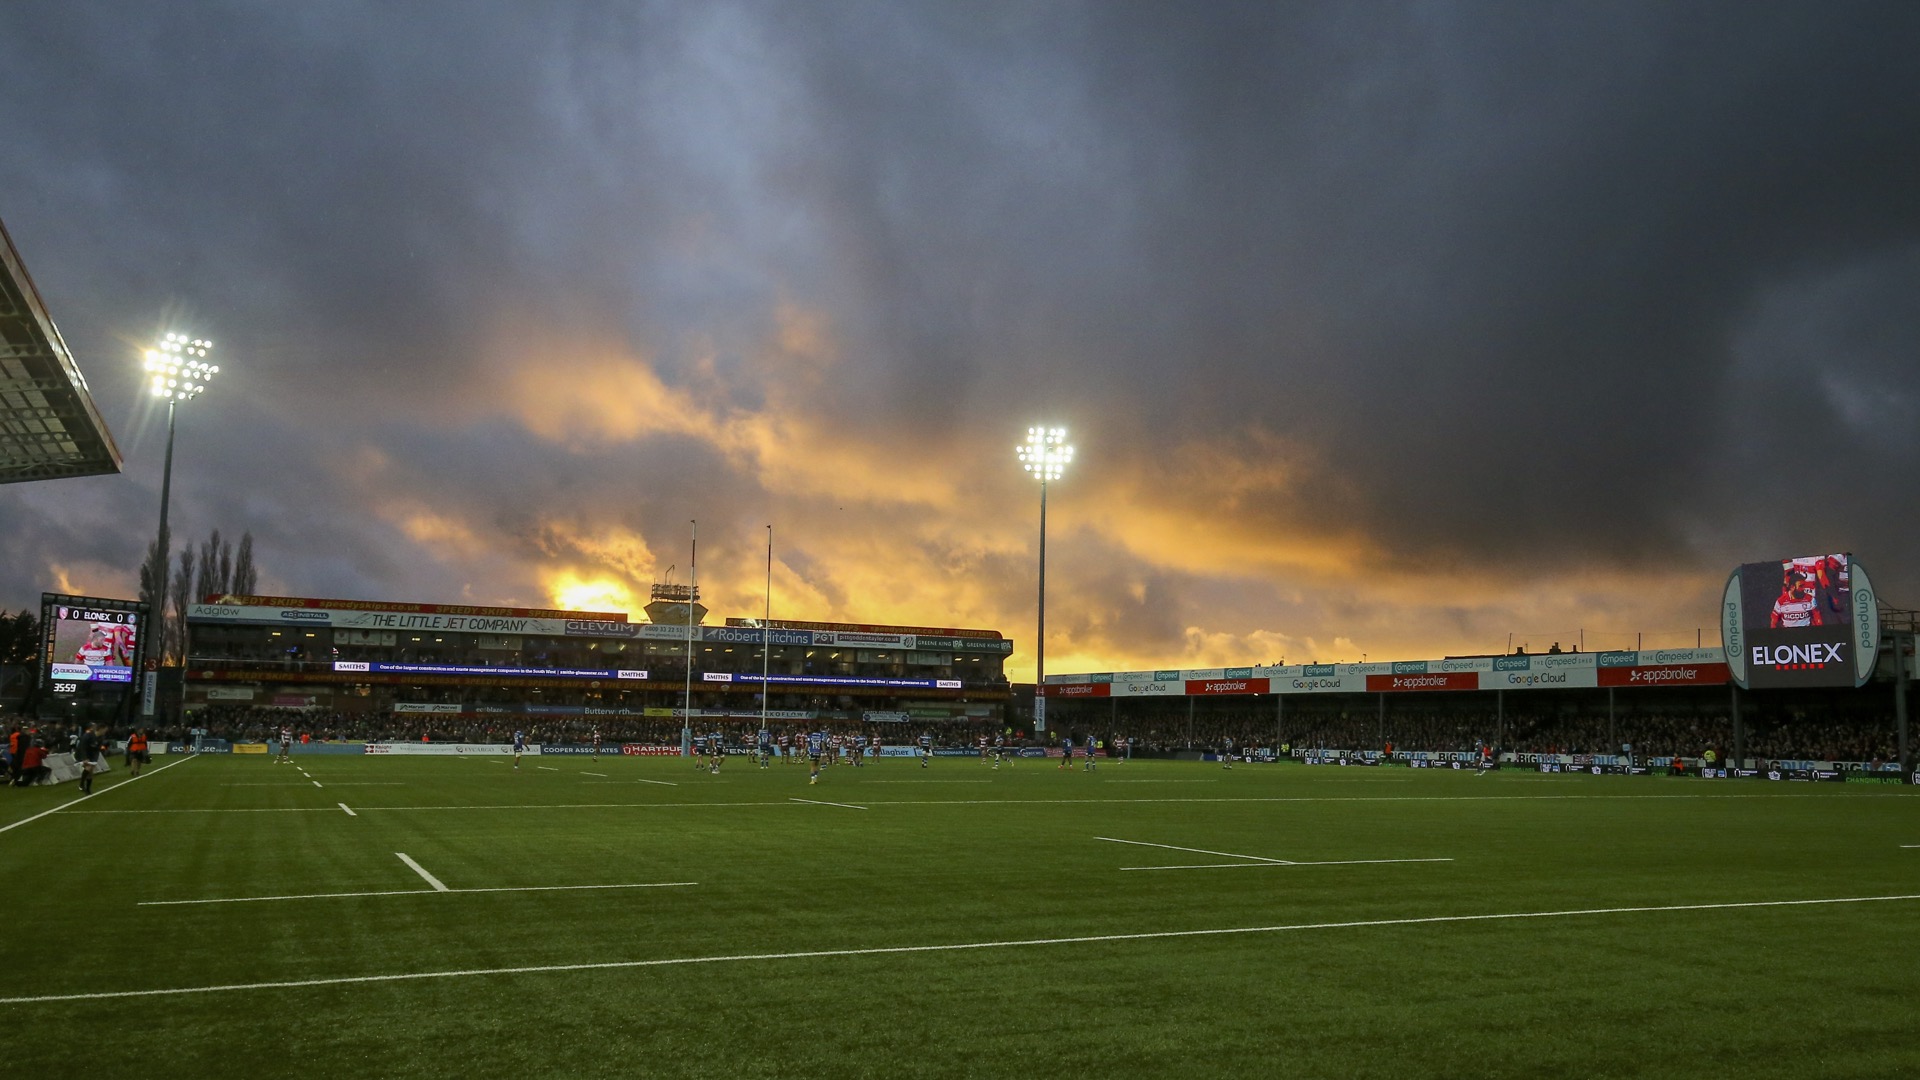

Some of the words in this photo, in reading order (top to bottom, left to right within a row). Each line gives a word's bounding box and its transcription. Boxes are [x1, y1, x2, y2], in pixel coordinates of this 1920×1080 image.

[270, 596, 305, 607] SKIPS
[319, 600, 420, 612] speedyskips.co.uk
[72, 609, 80, 619] 0
[84, 611, 112, 621] ELONEX
[116, 613, 124, 623] 0
[194, 605, 240, 617] Adglow
[435, 606, 478, 614] SPEEDY
[481, 608, 513, 616] SKIPS
[527, 610, 568, 618] SPEEDY
[373, 614, 397, 626] THE
[399, 615, 440, 628] LITTLE
[443, 617, 467, 629] JET
[468, 619, 528, 632] COMPANY
[1854, 588, 1874, 649] Compeed
[566, 622, 634, 632] GLEVUM
[796, 622, 831, 630] SPEEDY
[870, 626, 944, 635] speedyskips.co.uk
[1726, 602, 1742, 658] Compeed
[718, 628, 760, 642] Robert
[762, 630, 809, 644] Hitchins
[814, 634, 834, 642] PGT
[952, 640, 964, 648] IPA
[1000, 642, 1011, 650] IPA
[1655, 651, 1693, 664] Compeed
[1752, 642, 1843, 665] ELONEX
[1496, 658, 1527, 671] Compeed
[1544, 657, 1577, 669] Compeed
[1600, 653, 1634, 666] Compeed
[1305, 665, 1332, 676] Compeed
[1347, 664, 1376, 675] Compeed
[1394, 662, 1425, 674] Compeed
[1441, 660, 1473, 672] Compeed
[1122, 673, 1142, 682] Compeed
[1156, 671, 1178, 681] Compeed
[1189, 670, 1212, 680] Compeed
[1226, 669, 1250, 678] Compeed
[1263, 667, 1288, 677] Compeed
[1642, 667, 1697, 684] appsbroker
[1092, 674, 1111, 683] Compeed
[1403, 675, 1447, 689] appsbroker
[1508, 673, 1539, 686] Google
[1540, 672, 1566, 683] Cloud
[1128, 684, 1148, 694] Google
[1149, 683, 1166, 692] Cloud
[1213, 681, 1247, 693] appsbroker
[1292, 679, 1319, 690] Google
[1319, 679, 1340, 688] Cloud
[867, 748, 909, 757] Gllagher
[1882, 777, 1903, 785] LIVES
